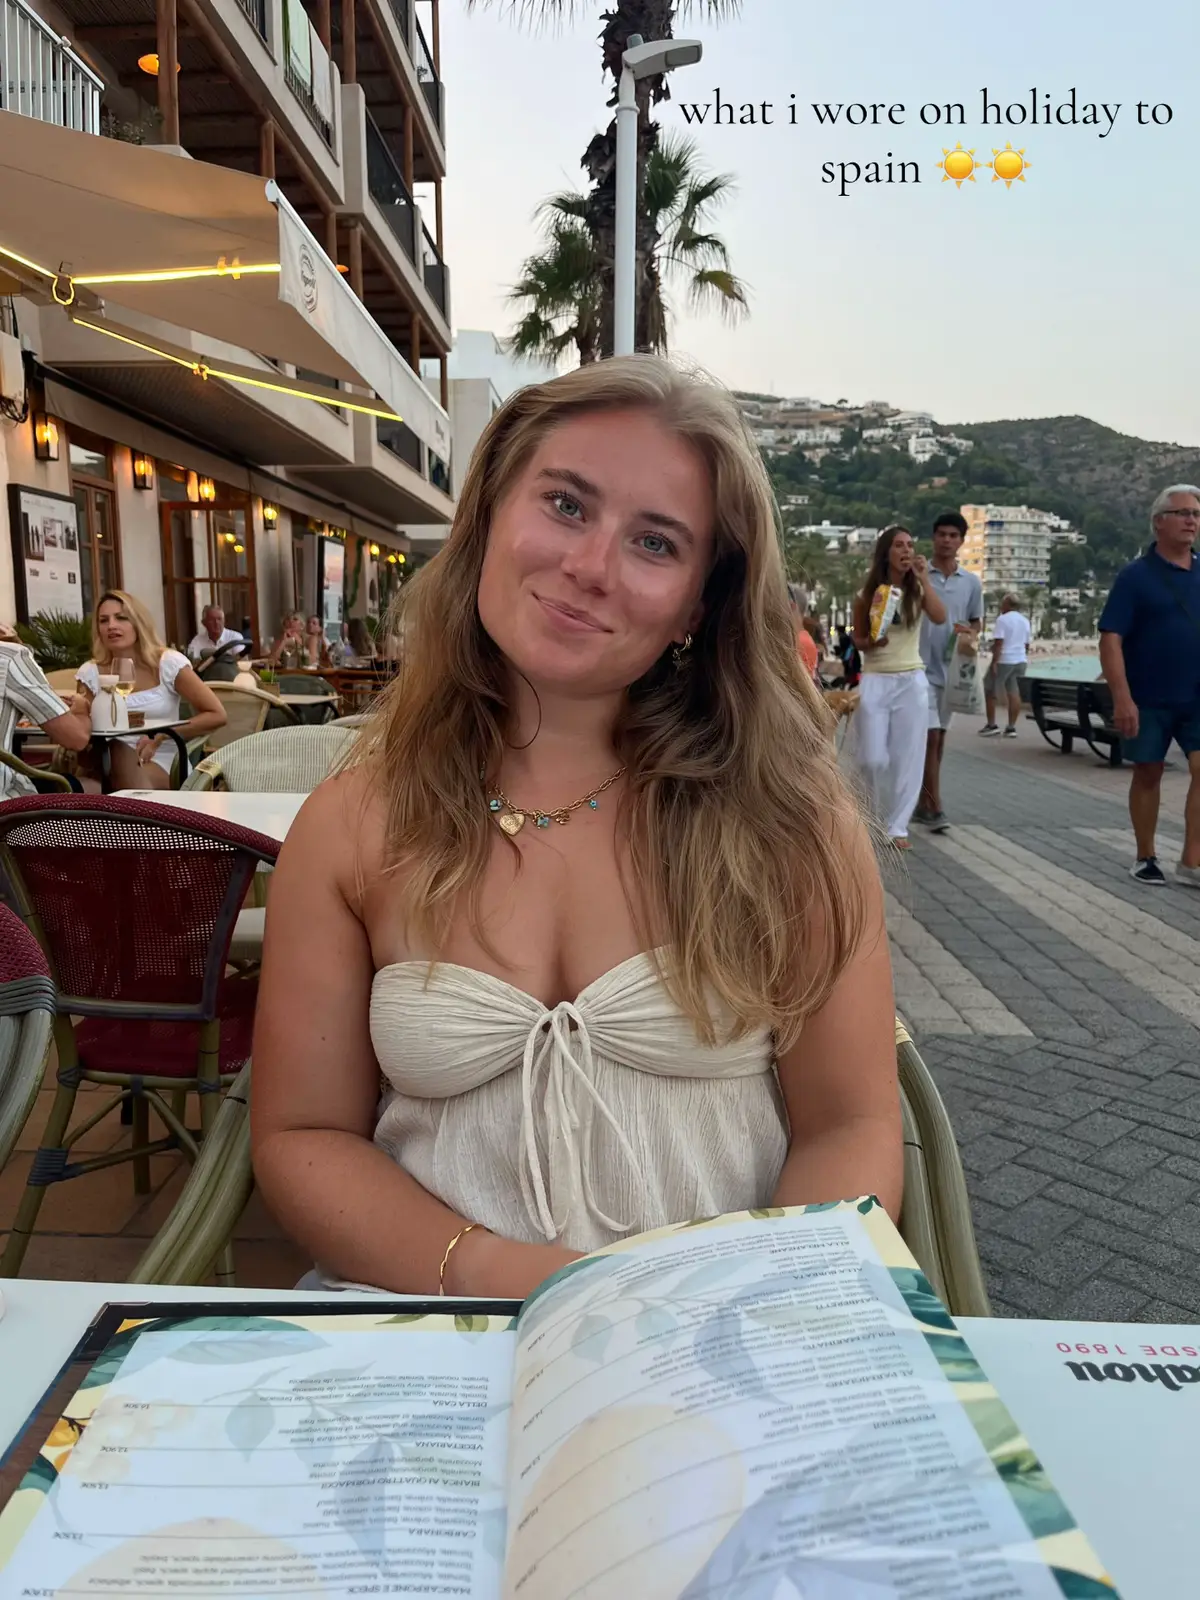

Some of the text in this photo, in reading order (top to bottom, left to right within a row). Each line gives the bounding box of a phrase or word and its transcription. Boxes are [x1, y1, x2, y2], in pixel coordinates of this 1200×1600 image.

[769, 1243, 825, 1253] MELANZANE
[793, 1270, 837, 1279] BURRATA
[816, 1296, 879, 1309] GAMBERETTI
[861, 1330, 895, 1339] POLLO
[802, 1336, 860, 1350] MARINATO
[1056, 1342, 1200, 1357] SDE 1890
[826, 1371, 897, 1387] PARMIGIANO
[1064, 1361, 1200, 1392] ahou
[873, 1413, 936, 1428] PEPPERONI
[415, 1442, 484, 1450] VEGETARIANA
[321, 1479, 376, 1490] FORMAGGI
[377, 1477, 427, 1485] QUATTRO
[442, 1479, 480, 1487] BIANCA
[408, 1528, 476, 1538] CARBONARA
[347, 1585, 381, 1594] SPECK
[382, 1584, 390, 1593] E
[391, 1584, 471, 1594] MASCARPONE
